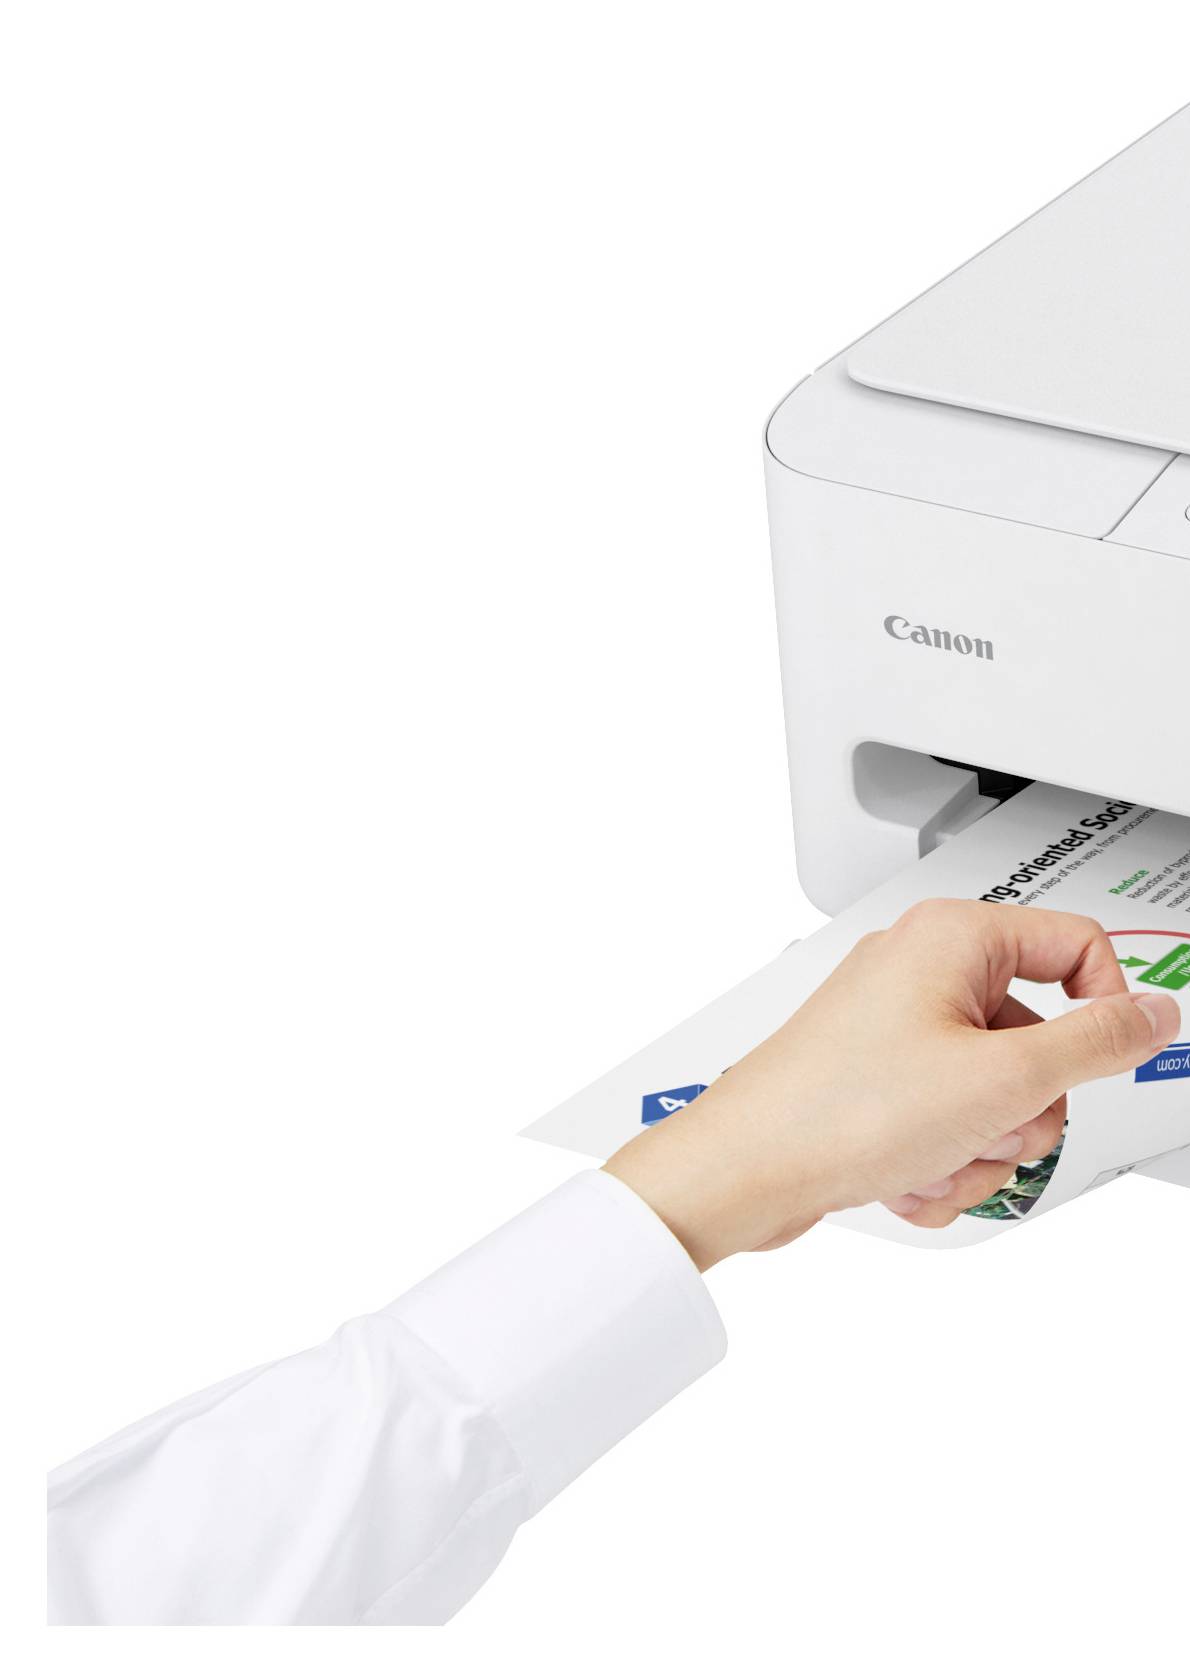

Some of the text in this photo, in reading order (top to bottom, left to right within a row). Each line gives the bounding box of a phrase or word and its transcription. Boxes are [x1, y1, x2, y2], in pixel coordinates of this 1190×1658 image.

[883, 615, 994, 661] Canon
[1018, 889, 1044, 905] every
[1040, 875, 1062, 890] step
[1058, 867, 1071, 879] of
[1066, 860, 1085, 872] the
[1108, 869, 1150, 895] Reduce
[1127, 873, 1166, 899] Reduction
